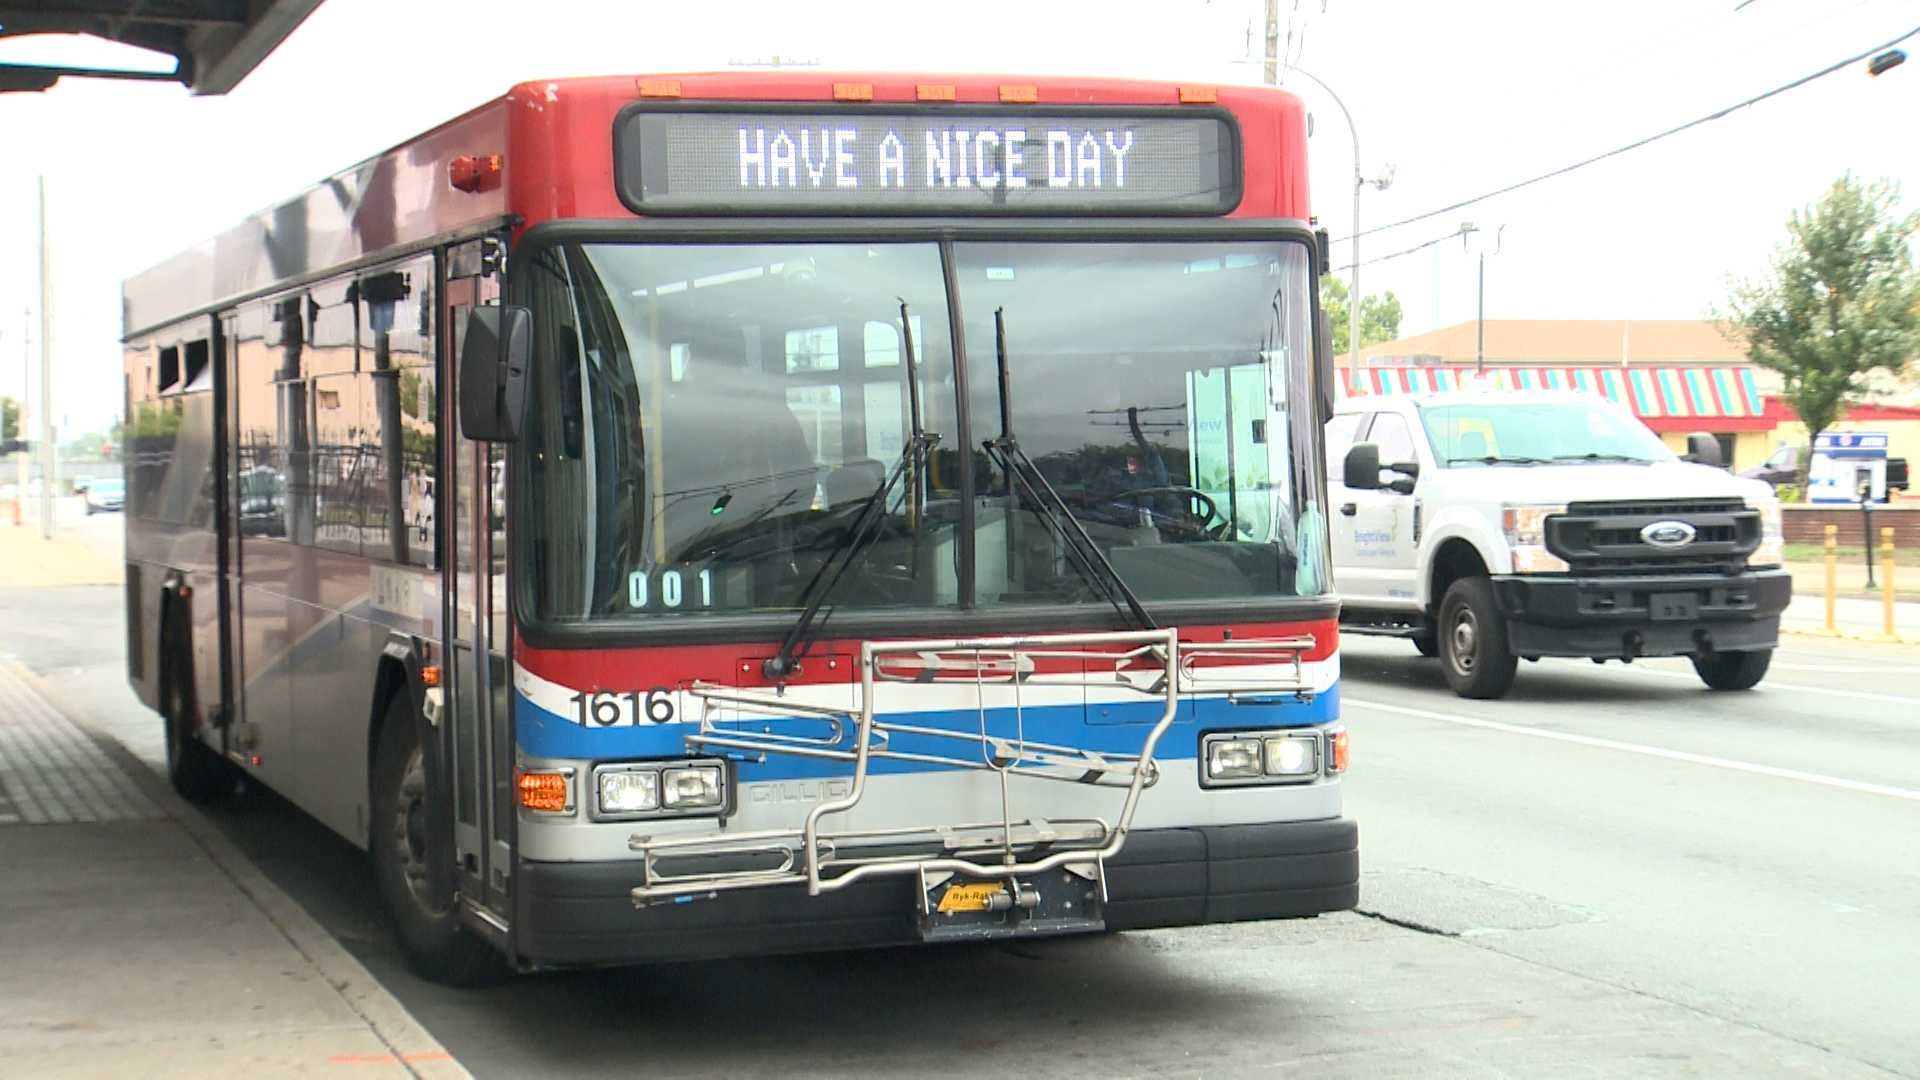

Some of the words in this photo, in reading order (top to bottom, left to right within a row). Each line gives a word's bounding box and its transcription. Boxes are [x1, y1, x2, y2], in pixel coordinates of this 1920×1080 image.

[739, 129, 858, 187] HAVE
[879, 129, 904, 187] A
[926, 130, 1027, 187] NICE
[1047, 130, 1133, 187] DAY
[570, 686, 674, 728] 1616
